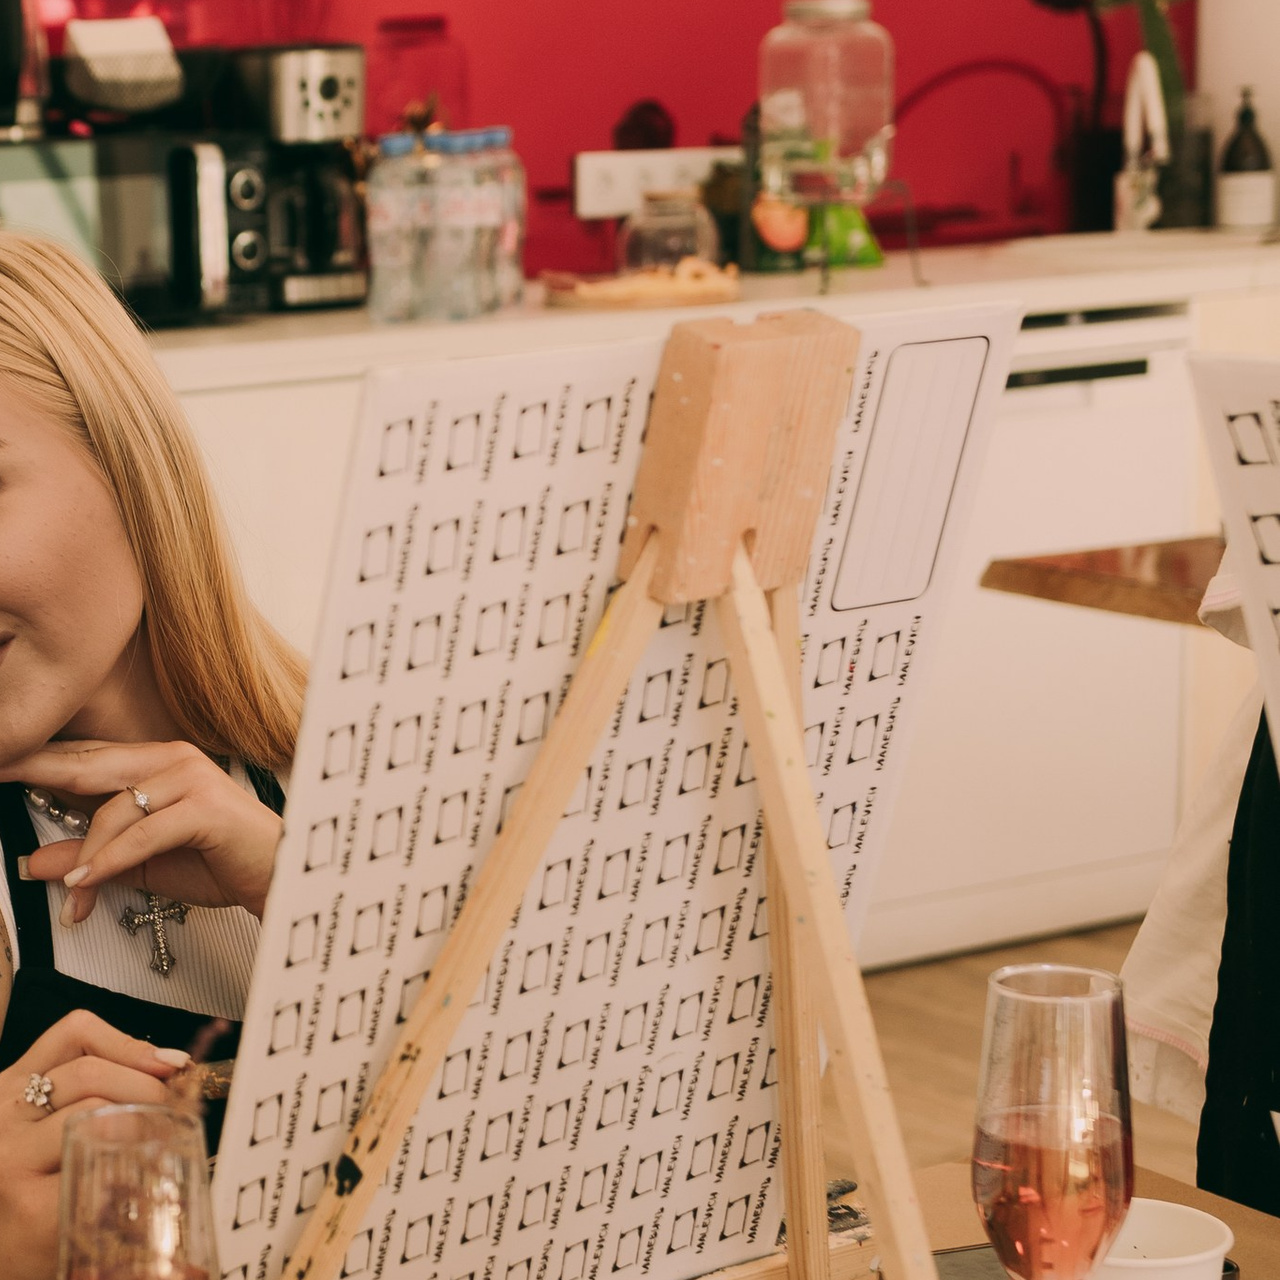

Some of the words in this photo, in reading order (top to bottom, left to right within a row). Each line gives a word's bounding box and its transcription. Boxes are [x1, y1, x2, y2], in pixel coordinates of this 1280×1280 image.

[590, 483, 612, 561] MALEVICH
[830, 451, 853, 526] MALEVICH
[379, 605, 397, 683] MALEVICH
[509, 584, 528, 661] MALEVICH
[897, 616, 921, 686] MALEVICH
[671, 653, 694, 727] MALEVICH
[424, 697, 443, 773] MALEVICH
[709, 727, 732, 799] MALEVICH
[821, 706, 845, 776] MALEVICH
[469, 773, 489, 847] MALEVICH
[592, 750, 613, 822] MALEVICH
[853, 787, 876, 854] MALEVICH
[341, 799, 360, 875] MALEVICH
[629, 832, 651, 902] MALEVICH
[385, 884, 405, 957] MALEVICH
[668, 900, 690, 968] MALEVICH
[552, 926, 573, 995] MALEVICH
[304, 983, 323, 1056] MALEVICH
[588, 1003, 610, 1070] MALEVICH
[701, 975, 724, 1041] MALEVICH
[347, 1062, 372, 1134] MALEVICH
[471, 1031, 492, 1100] MALEVICH
[626, 1065, 651, 1130] MALEVICH
[735, 1037, 759, 1102] MALEVICH
[392, 1126, 413, 1195] MALEVICH
[512, 1094, 533, 1161] MALEVICH
[268, 1159, 287, 1229] MALEVICH
[549, 1165, 570, 1230] MALEVICH
[660, 1135, 682, 1198] MALEVICH
[433, 1197, 454, 1264] MALEVICH
[695, 1192, 717, 1254] MALEVICH
